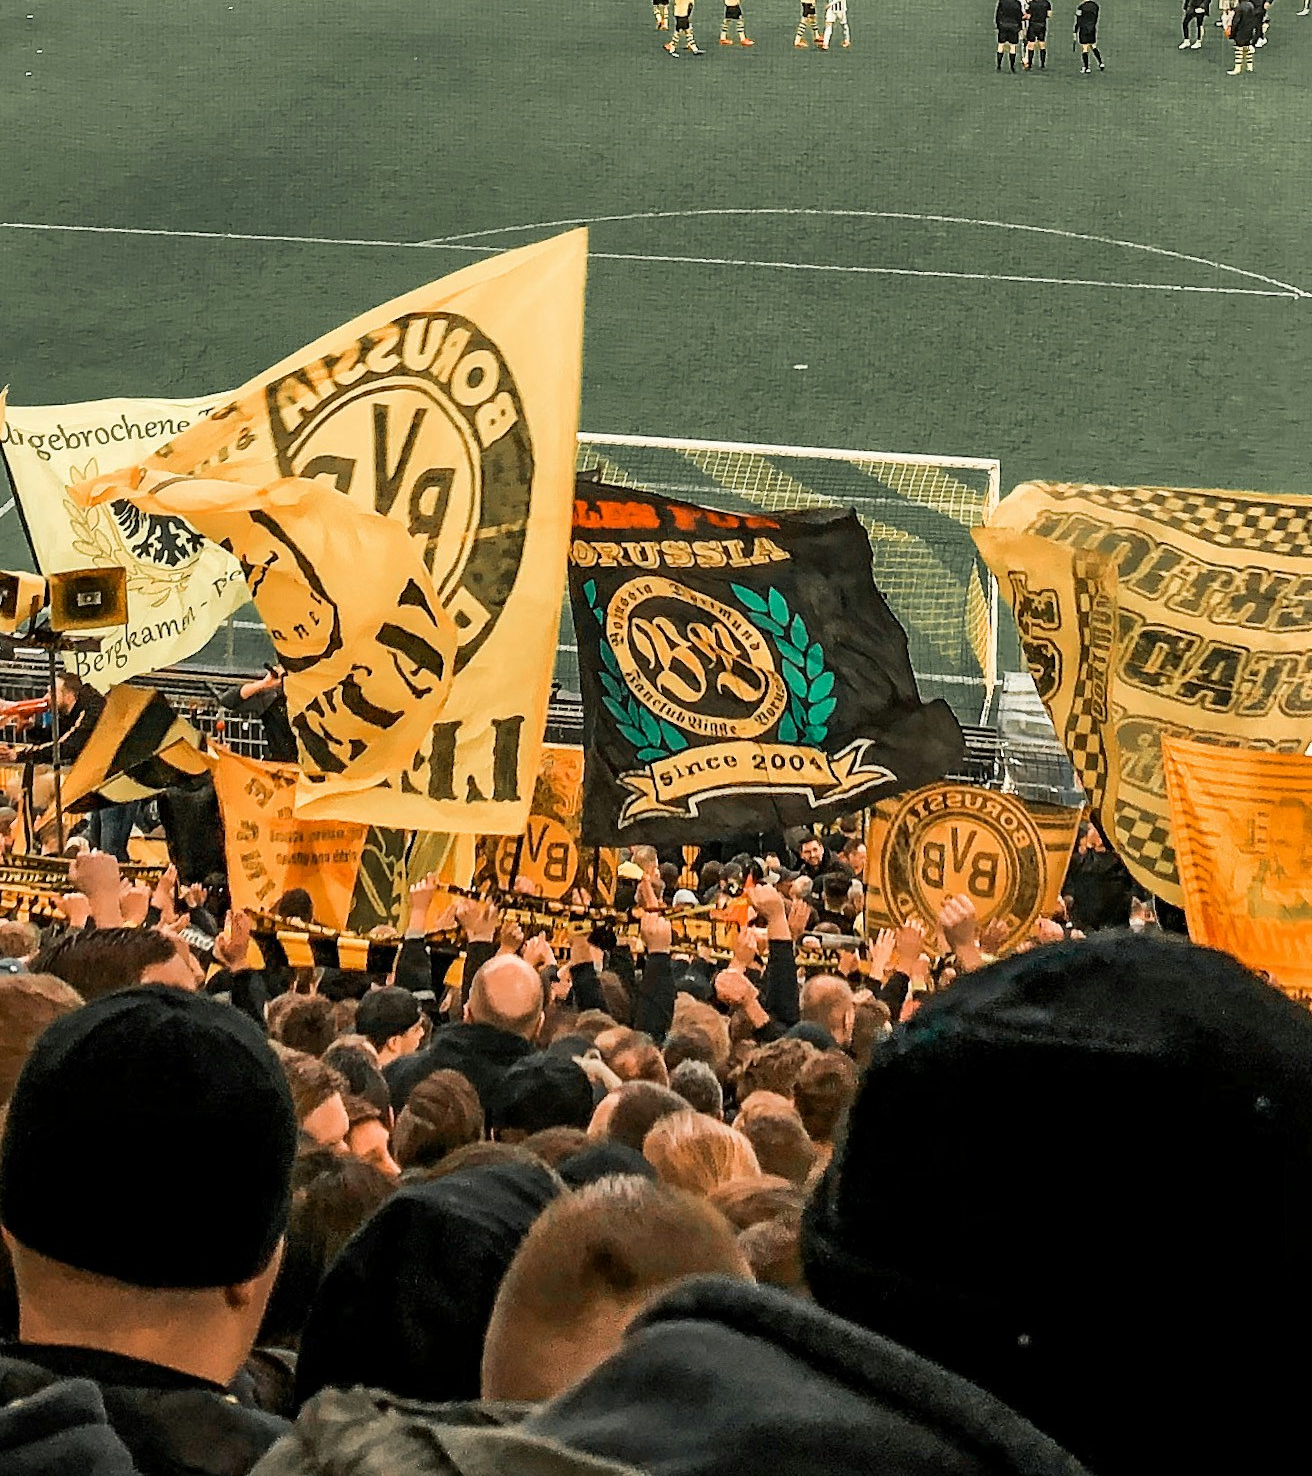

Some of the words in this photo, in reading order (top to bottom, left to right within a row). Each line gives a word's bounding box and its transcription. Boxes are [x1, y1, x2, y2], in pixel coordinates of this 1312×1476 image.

[571, 538, 791, 568] ORUSSIA
[669, 582, 761, 651] Dortmund
[625, 669, 687, 724] Fanclub
[659, 754, 738, 786] since
[752, 751, 825, 773] 2004
